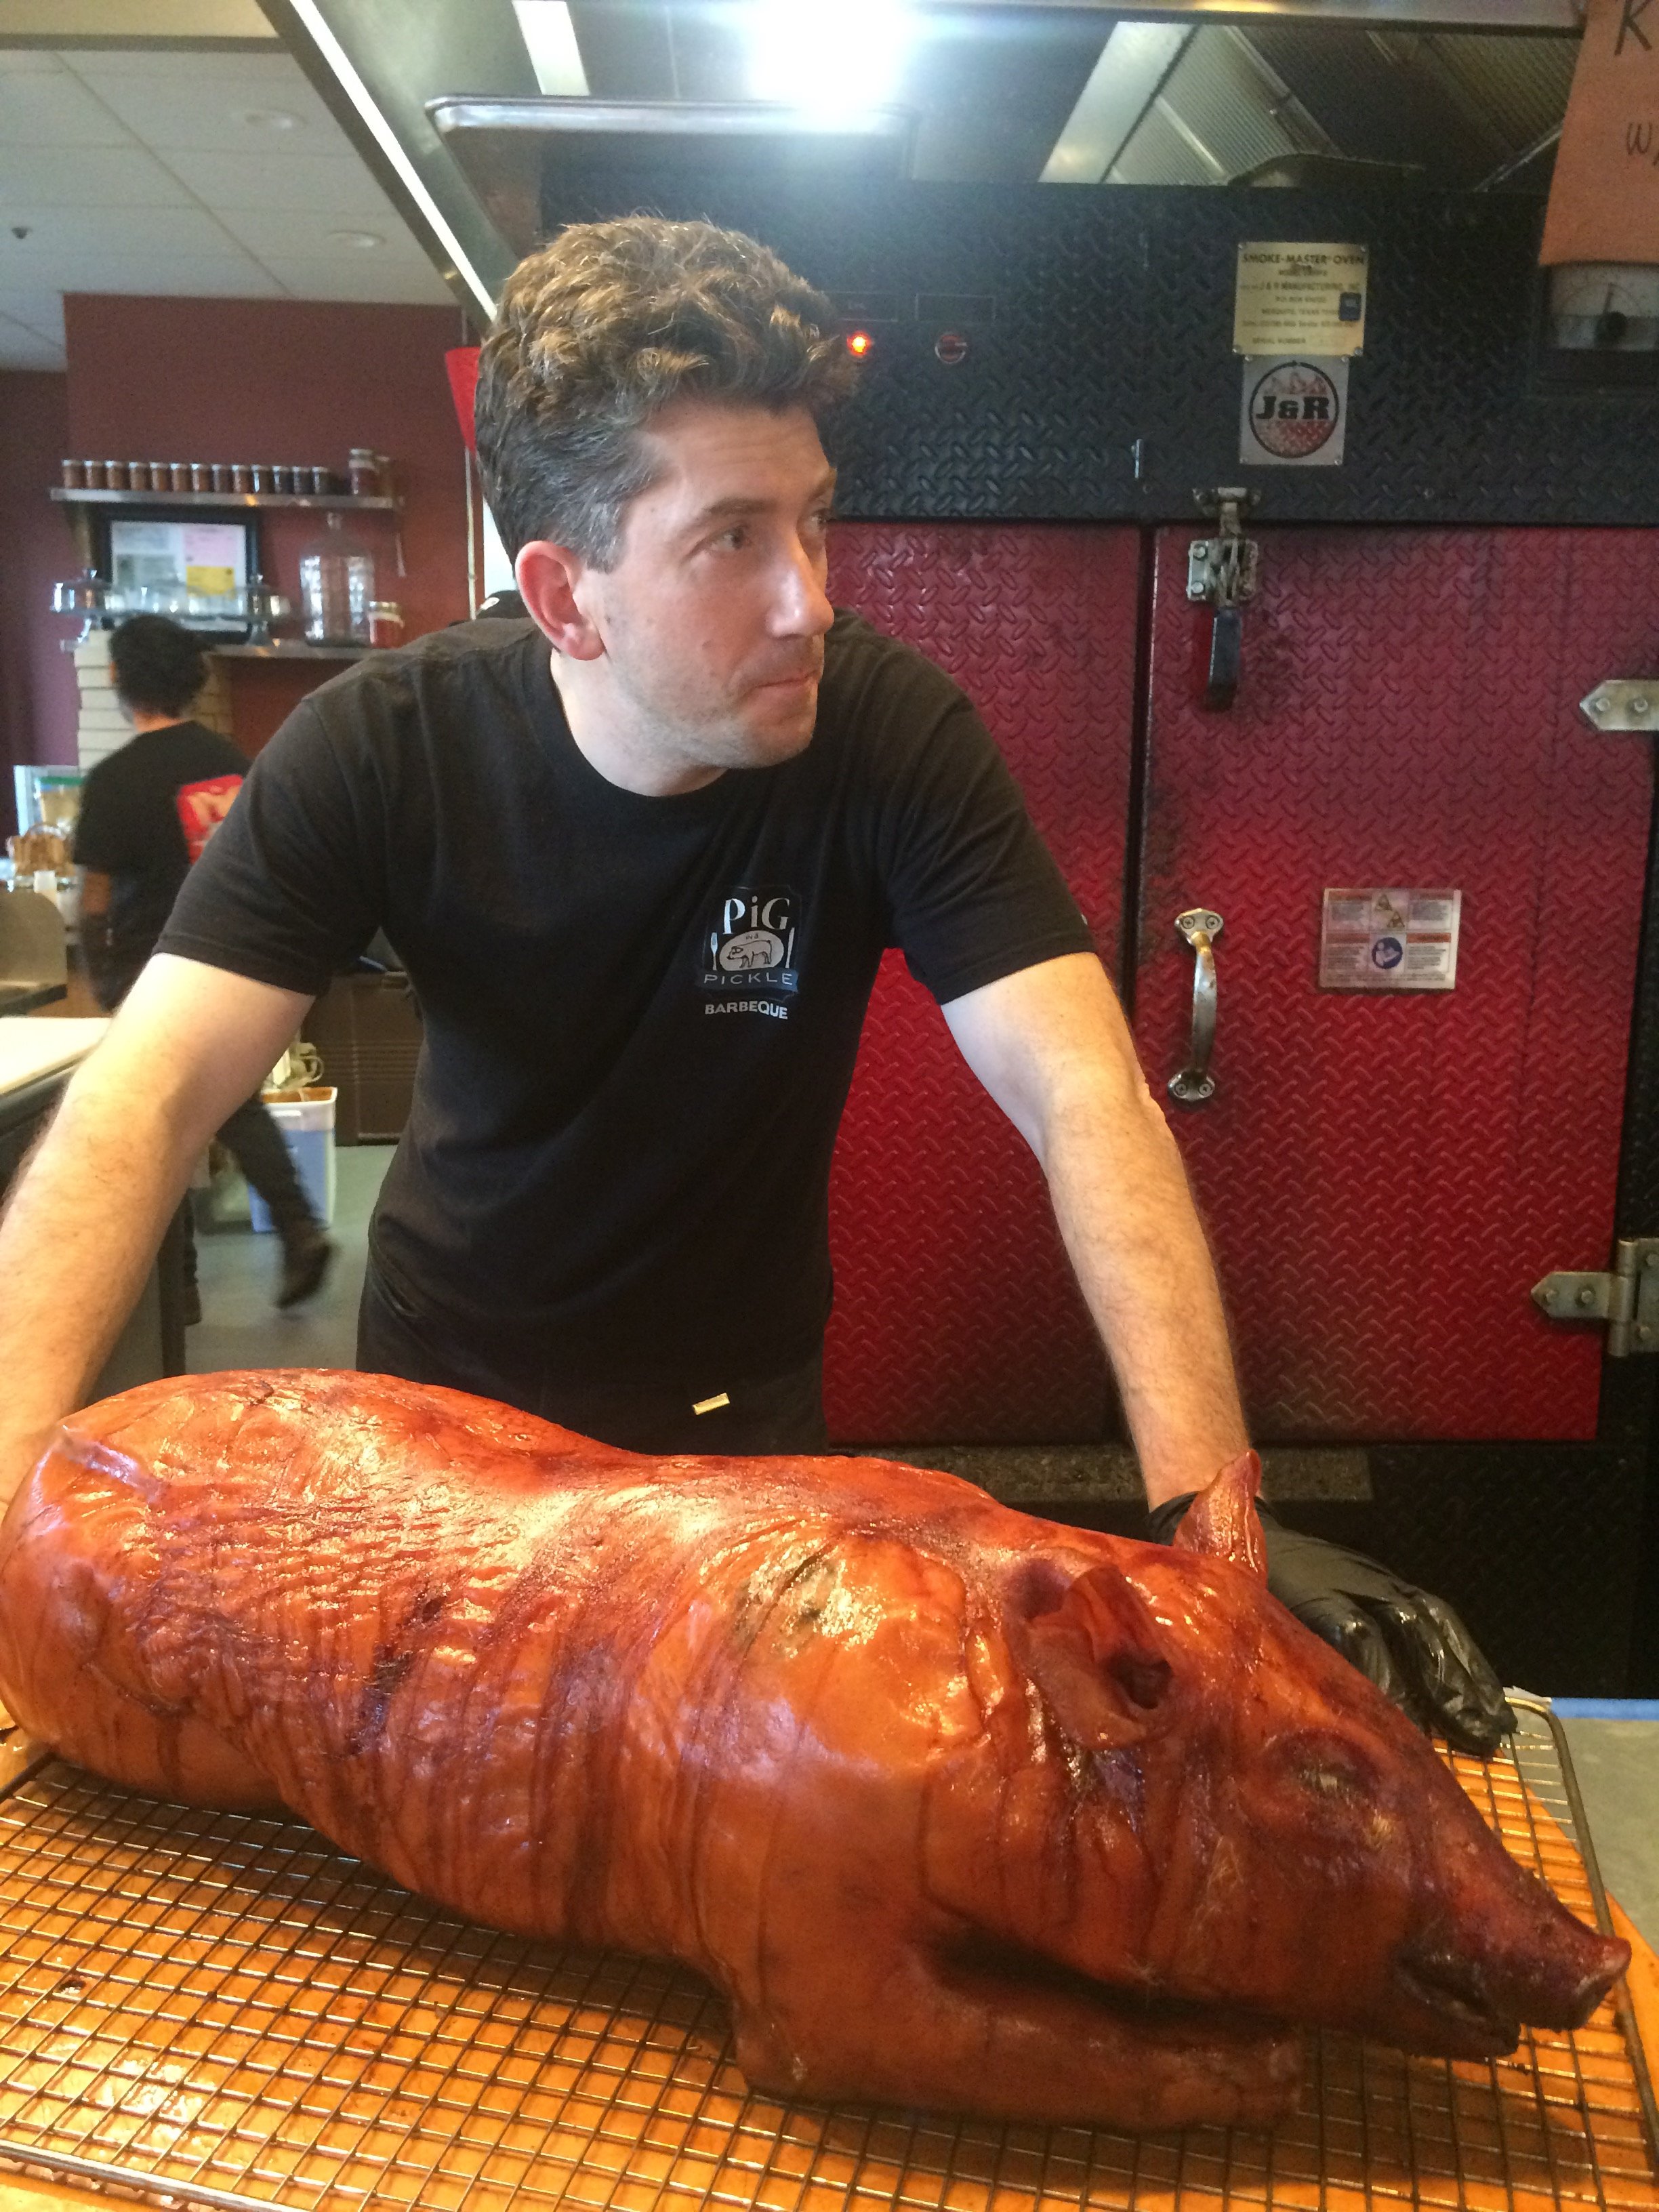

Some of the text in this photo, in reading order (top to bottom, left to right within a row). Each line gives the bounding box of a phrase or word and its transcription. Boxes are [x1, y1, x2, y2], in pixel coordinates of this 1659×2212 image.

[1332, 254, 1364, 265] OVEN
[703, 972, 793, 985] PICKLE
[705, 1000, 788, 1020] BARBEQUE
